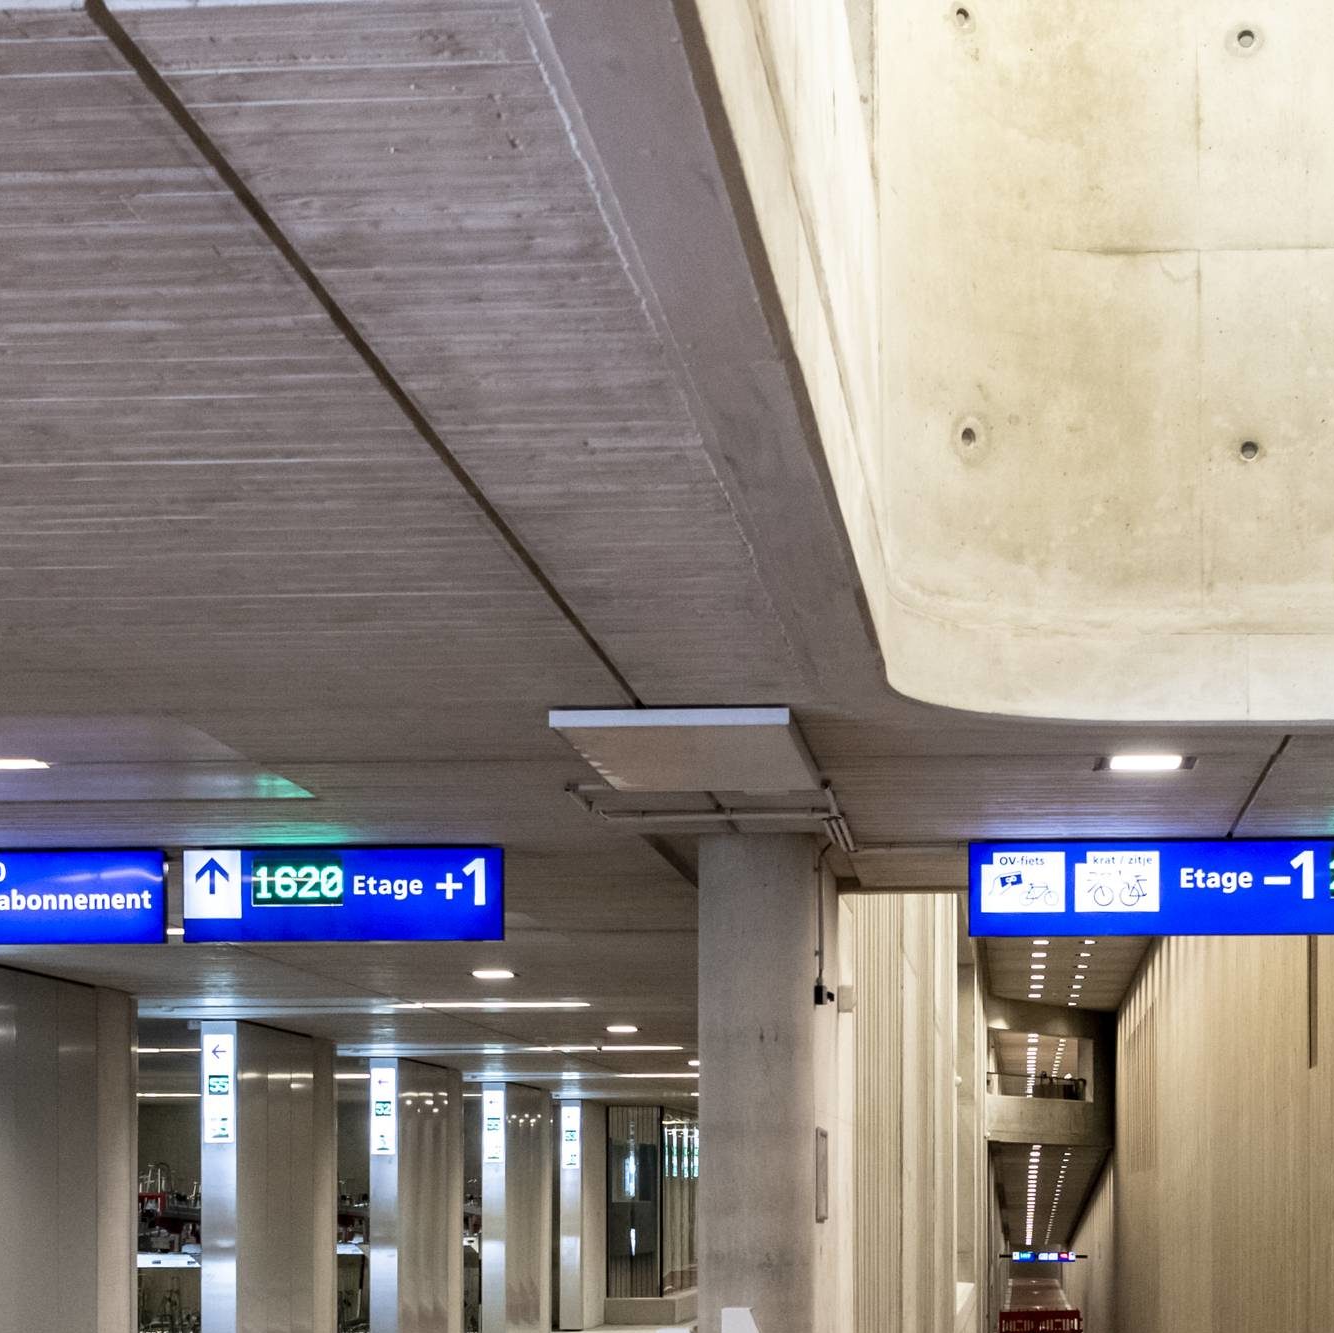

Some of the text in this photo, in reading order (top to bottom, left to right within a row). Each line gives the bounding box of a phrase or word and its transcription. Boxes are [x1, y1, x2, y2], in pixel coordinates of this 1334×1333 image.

[999, 856, 1045, 866] OV-fiets
[1092, 855, 1116, 865] krat
[1128, 855, 1153, 867] zitje
[255, 866, 344, 899] 1620
[353, 858, 486, 906] Etage +1
[1179, 867, 1253, 893] Etage
